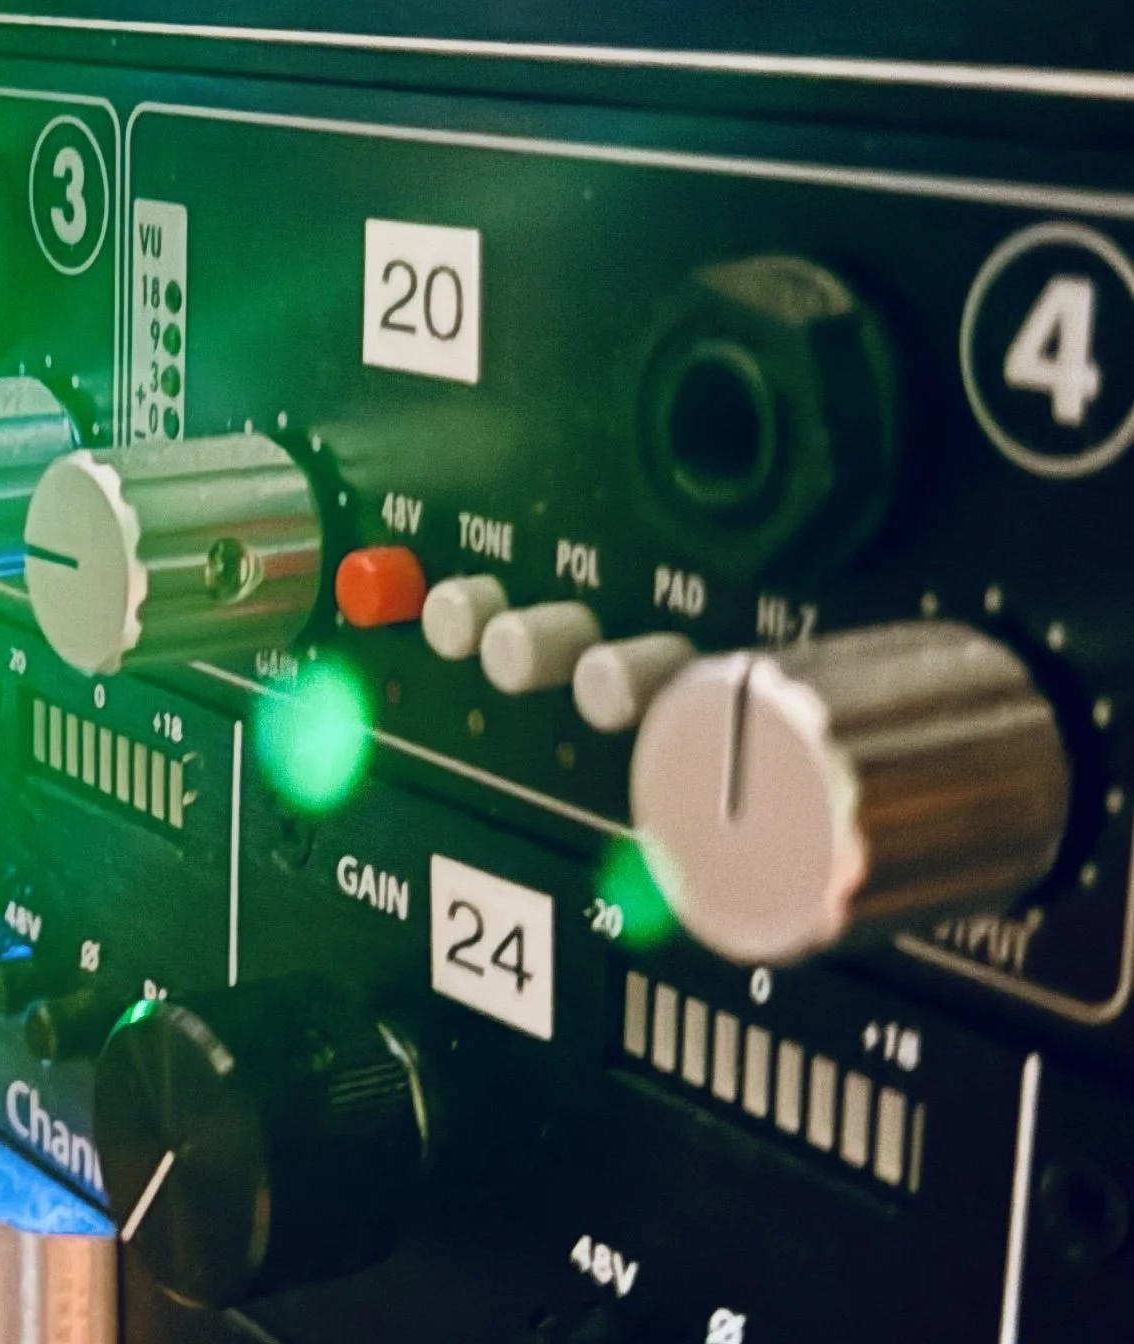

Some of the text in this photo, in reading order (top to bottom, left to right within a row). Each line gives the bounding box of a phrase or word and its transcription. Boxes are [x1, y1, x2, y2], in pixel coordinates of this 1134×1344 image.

[50, 147, 89, 246] 3
[139, 223, 163, 258] VU
[142, 273, 162, 309] 18
[378, 258, 465, 343] 20
[150, 318, 162, 351] 9
[1003, 274, 1102, 428] 4
[381, 491, 423, 536] 48V
[459, 512, 514, 563] TONE
[556, 538, 601, 589] POL
[654, 563, 705, 618] PAD
[94, 683, 106, 709] 0
[336, 856, 410, 921] GAIN
[444, 899, 535, 994] 24
[750, 966, 773, 1006] 0
[570, 1234, 639, 1298] 48V
